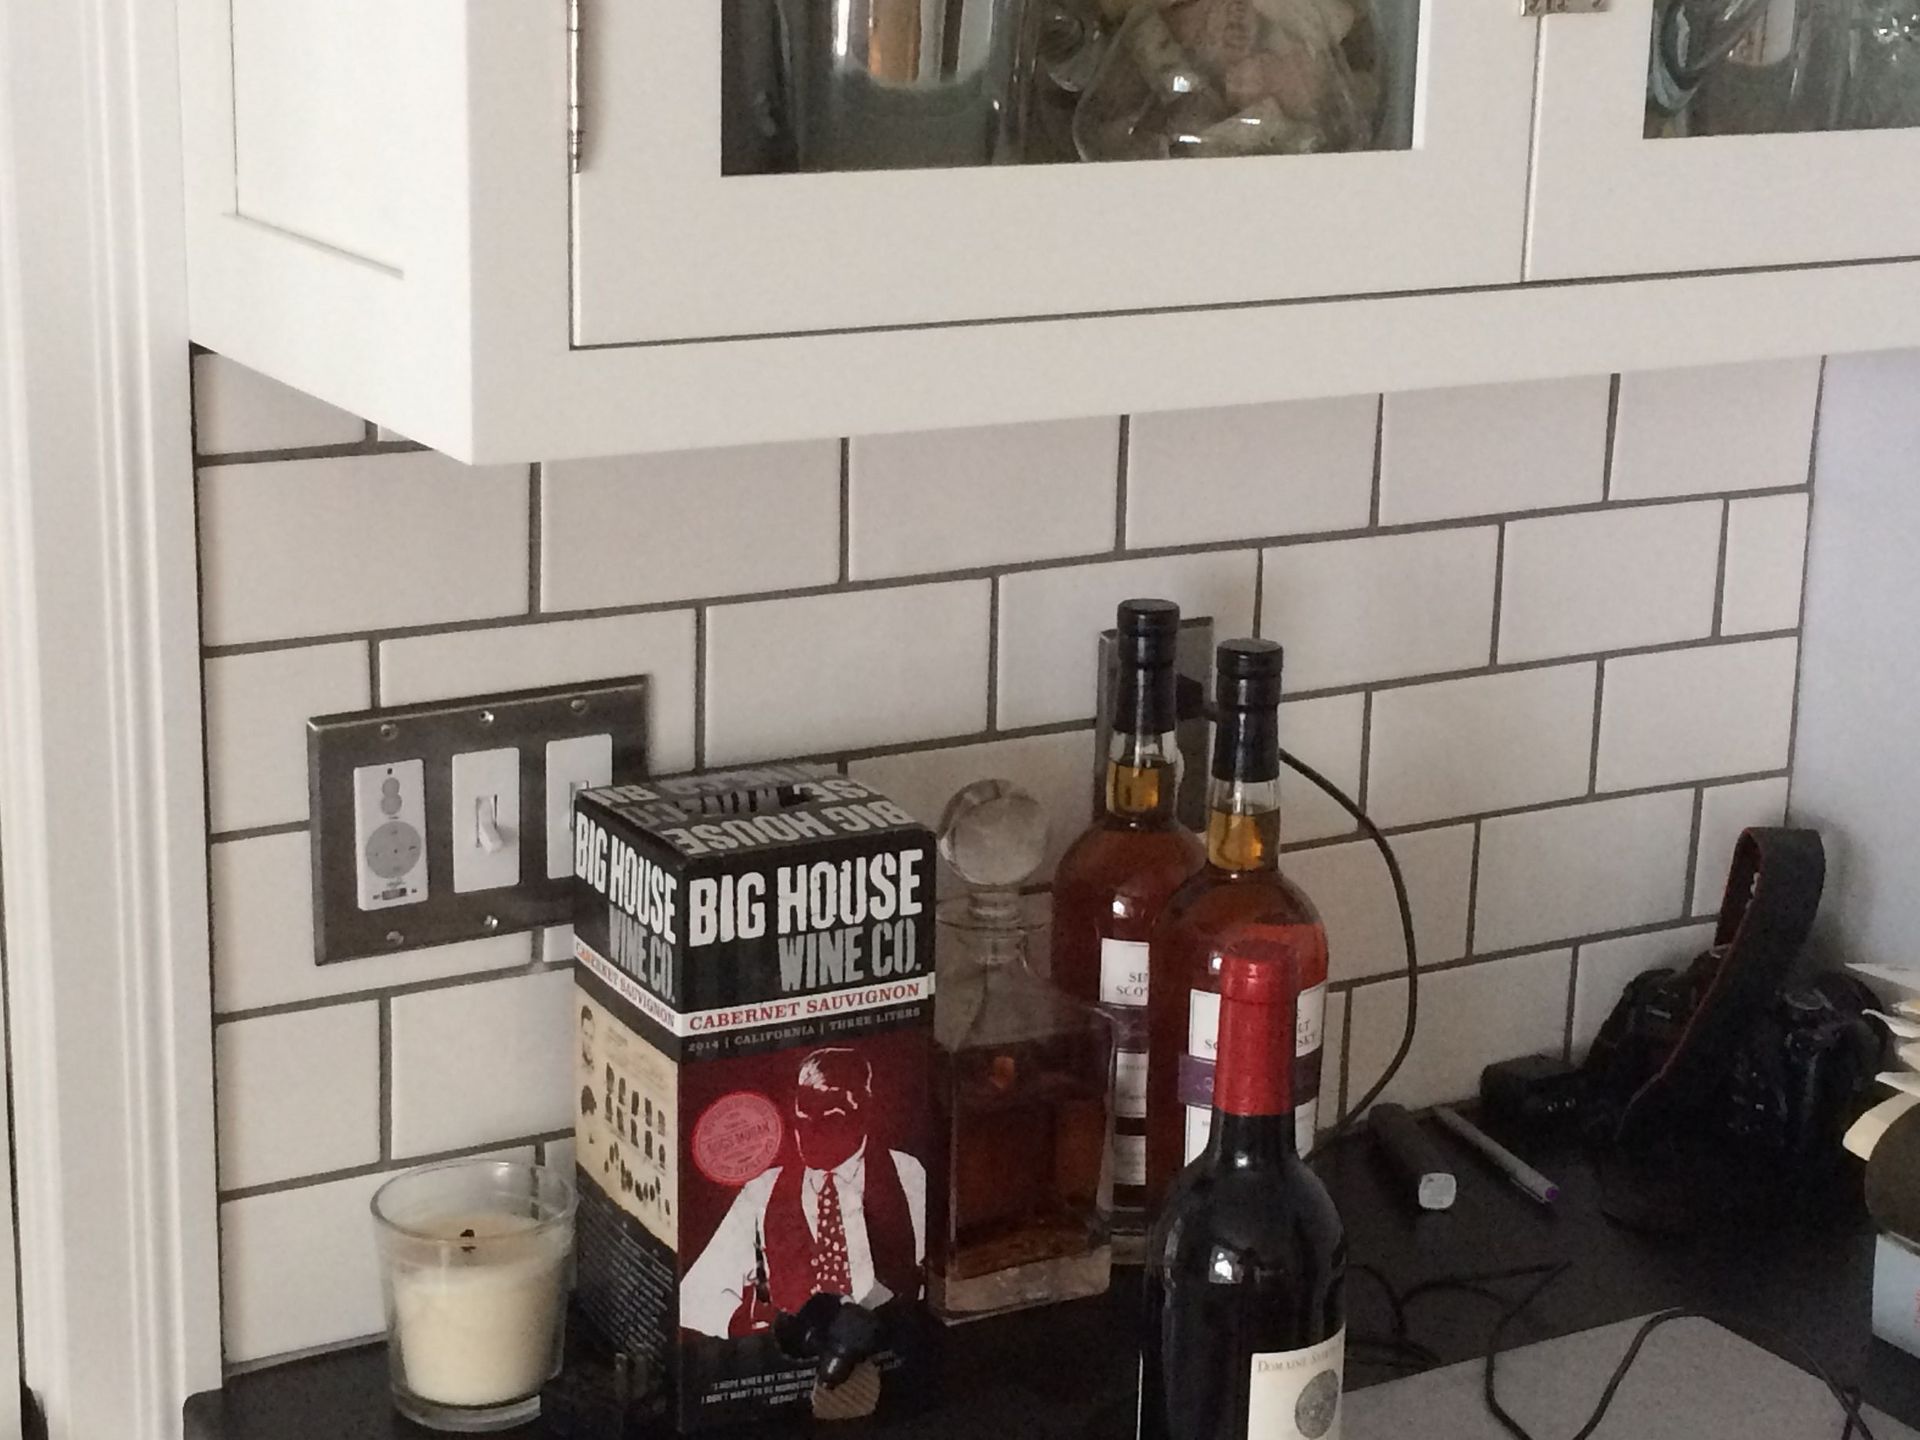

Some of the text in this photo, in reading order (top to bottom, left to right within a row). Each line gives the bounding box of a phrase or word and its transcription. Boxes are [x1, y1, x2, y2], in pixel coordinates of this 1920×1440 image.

[660, 800, 917, 856] BIG HOUSE
[575, 811, 678, 945] BIG HOUSE
[689, 848, 923, 948] BIG HOUSE
[609, 903, 676, 1004] WINE CO.
[777, 917, 922, 993] WINE CO.
[620, 975, 675, 1028] SAUVIGNON
[687, 1006, 922, 1053] 2014 CALIFORNIA THREE LITERS
[689, 981, 921, 1032] CABERNET SAUVIGNON
